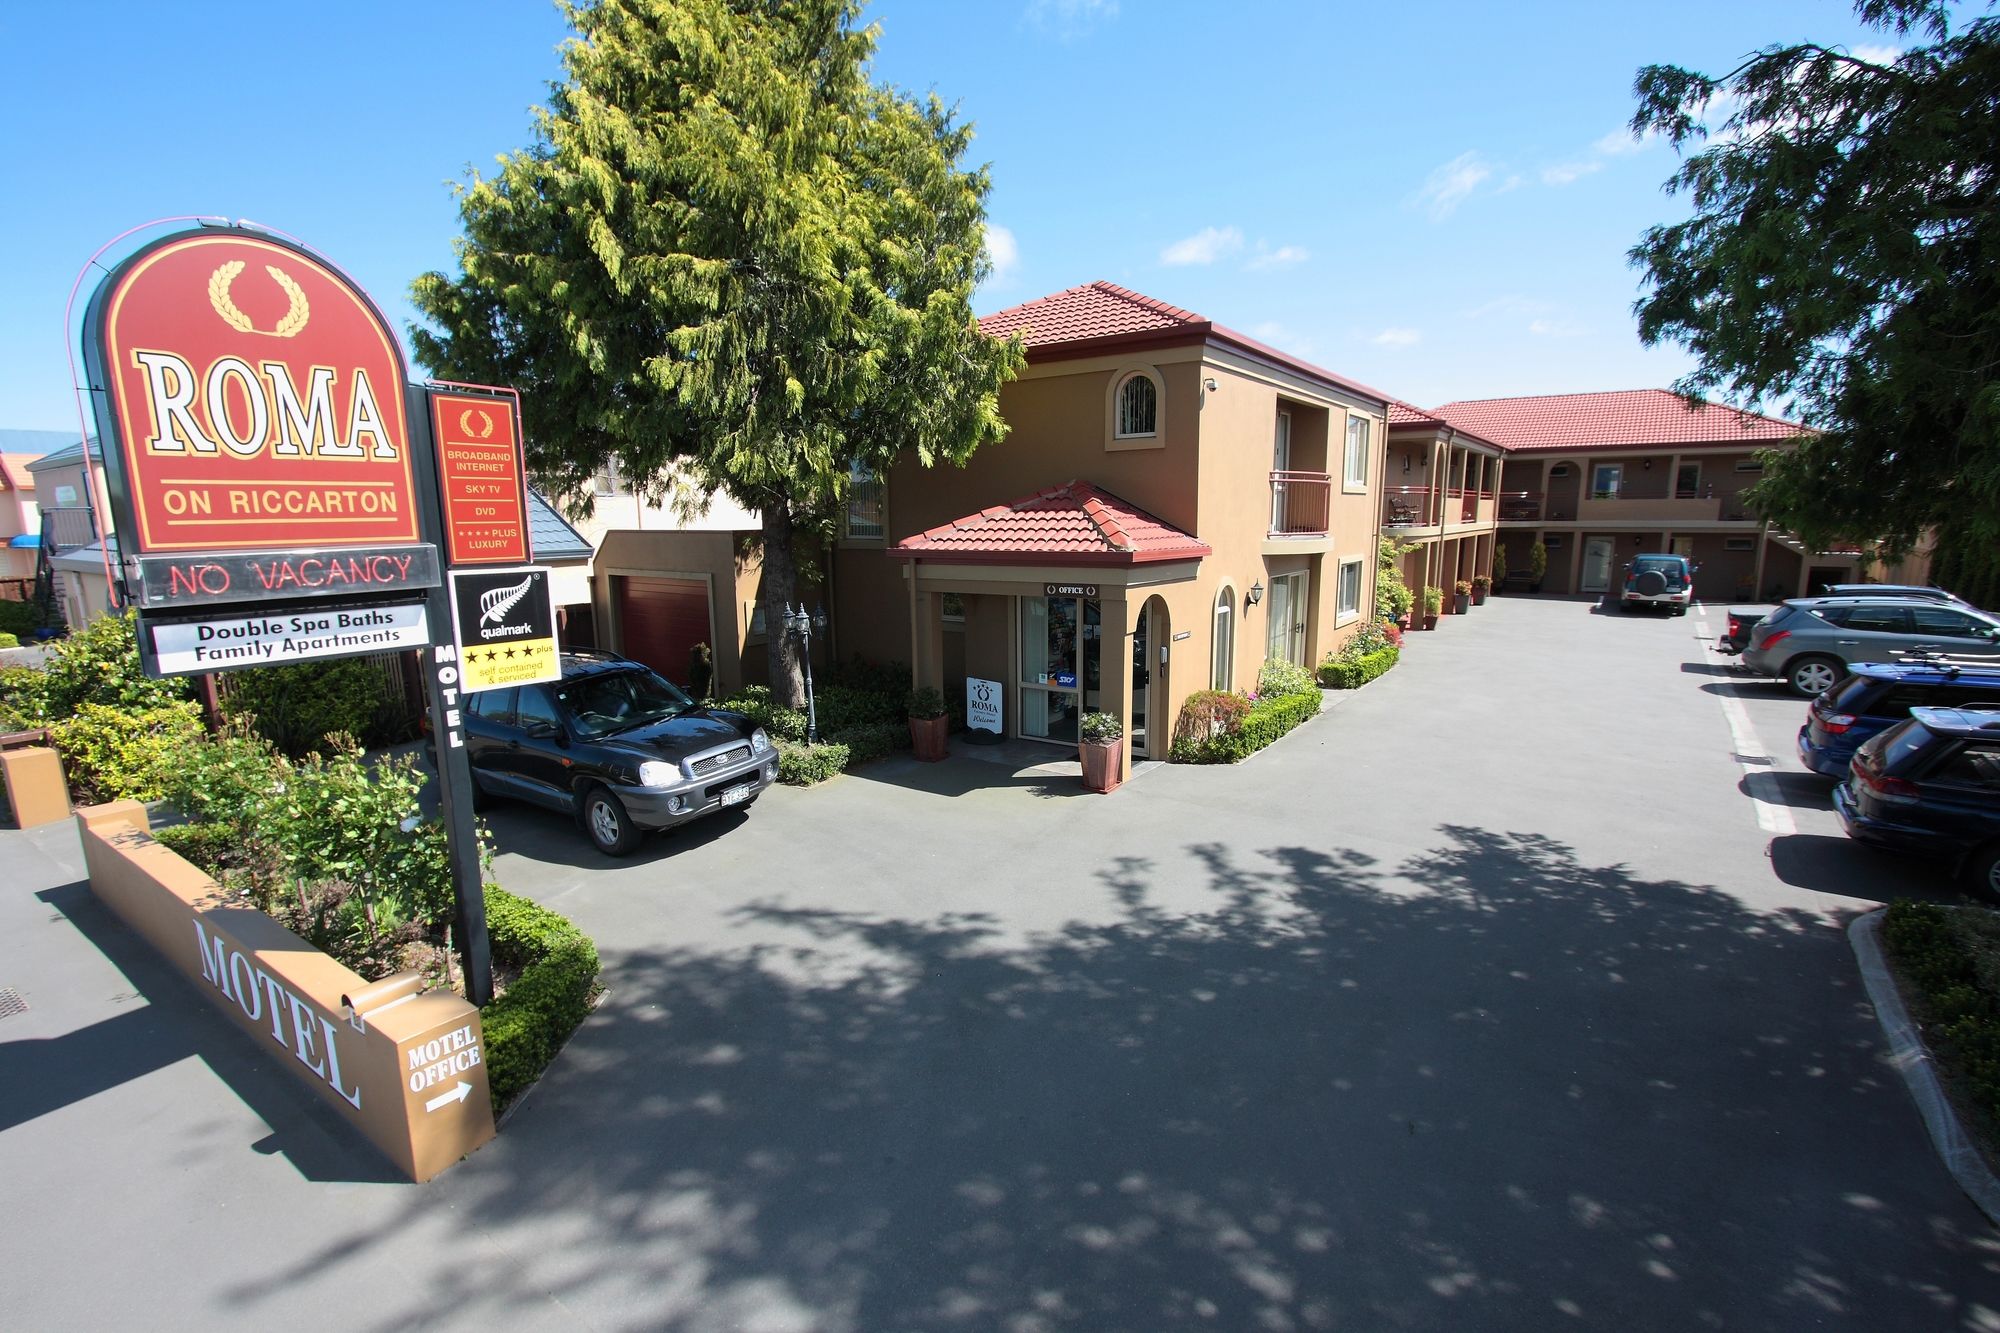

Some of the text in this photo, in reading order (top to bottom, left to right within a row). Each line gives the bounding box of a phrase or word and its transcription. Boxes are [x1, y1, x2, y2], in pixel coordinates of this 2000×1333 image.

[132, 348, 399, 460] ROMA
[447, 450, 511, 461] BROADBAND
[456, 463, 504, 472] INTERNET
[465, 485, 501, 493] SKY TV
[163, 489, 397, 514] ON RICCARTON
[475, 507, 496, 516] DVD
[491, 529, 517, 537] PLUS
[469, 540, 508, 549] LUXURY
[170, 555, 412, 595] NO VACANCY
[1058, 586, 1084, 594] OFFICE
[197, 611, 394, 641] Double Spa Baths
[480, 622, 532, 639] qualmark
[195, 629, 401, 662] Family Apartments
[536, 645, 553, 654] plus
[479, 660, 543, 677] self contained
[488, 671, 537, 685] & serviced
[435, 644, 464, 749] MOTEL
[971, 700, 998, 713] ROMA
[193, 919, 360, 1110] MOTEL
[407, 1025, 477, 1071] MOTEL
[409, 1046, 480, 1093] OFFICE
